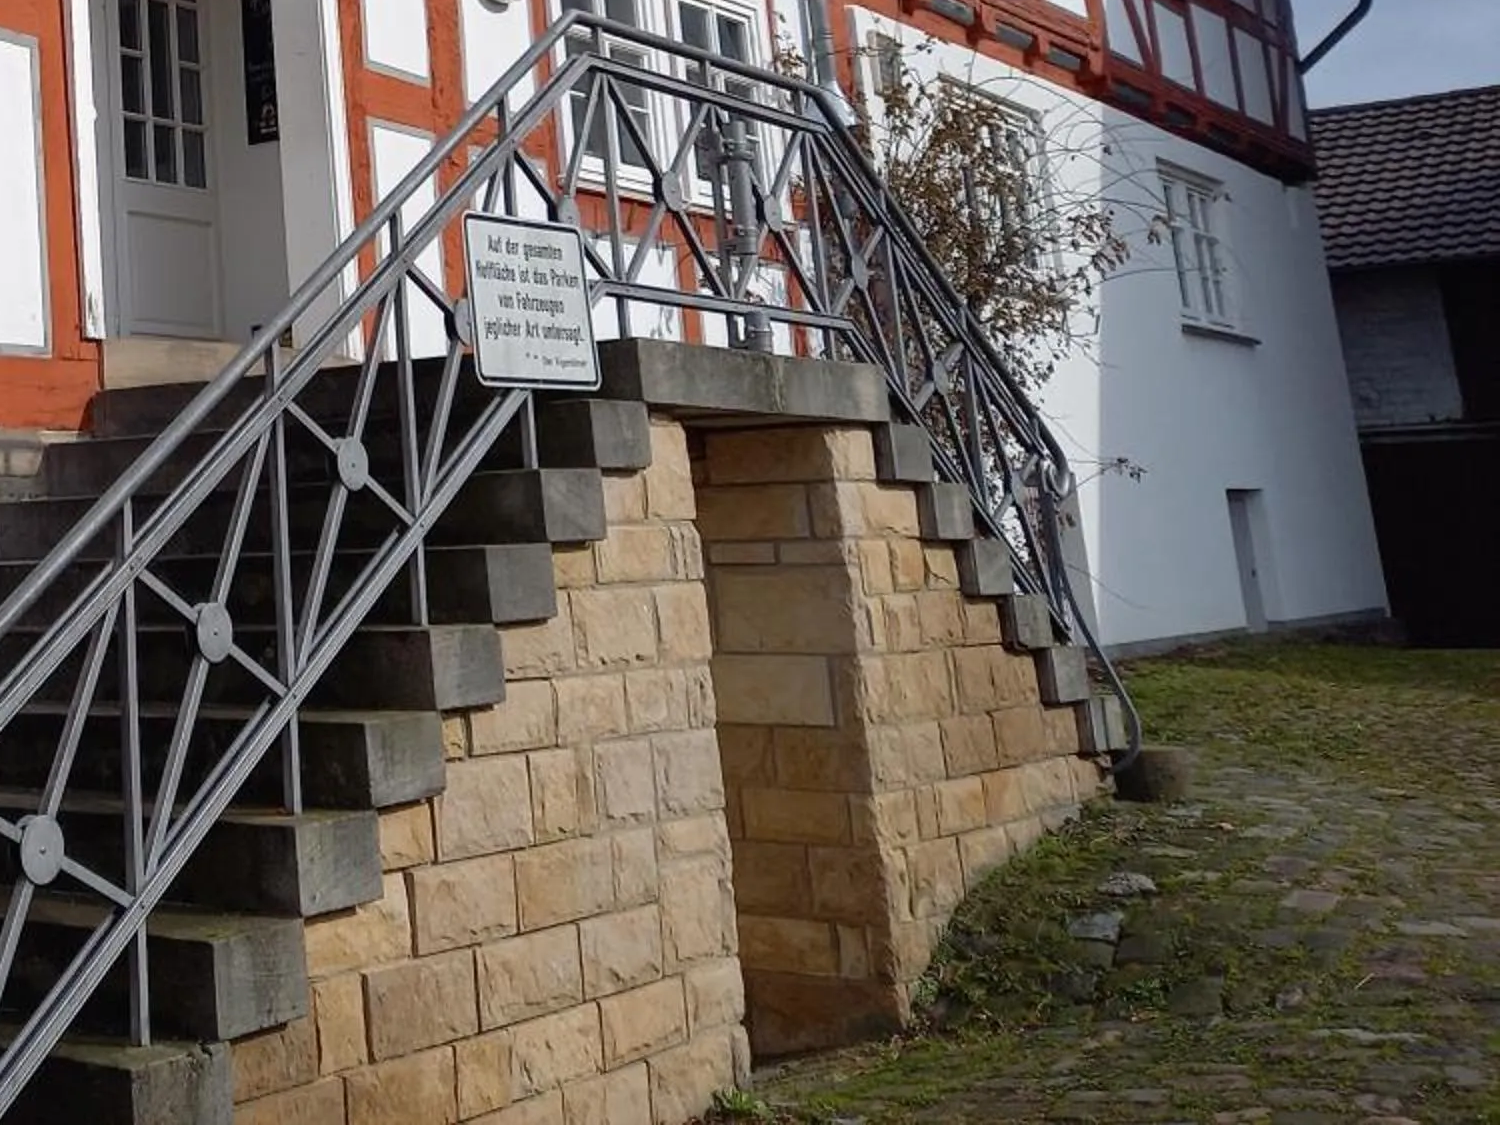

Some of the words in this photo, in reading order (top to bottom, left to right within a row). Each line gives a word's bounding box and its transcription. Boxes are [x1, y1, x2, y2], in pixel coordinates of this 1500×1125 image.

[487, 234, 502, 253] Auf
[505, 236, 519, 255] der
[518, 264, 531, 284] ist
[533, 267, 549, 286] das
[550, 268, 579, 288] Parken
[498, 294, 514, 310] von
[515, 290, 565, 317] Fahrzeugen
[483, 316, 521, 340] jeglicher
[525, 318, 540, 338] Art
